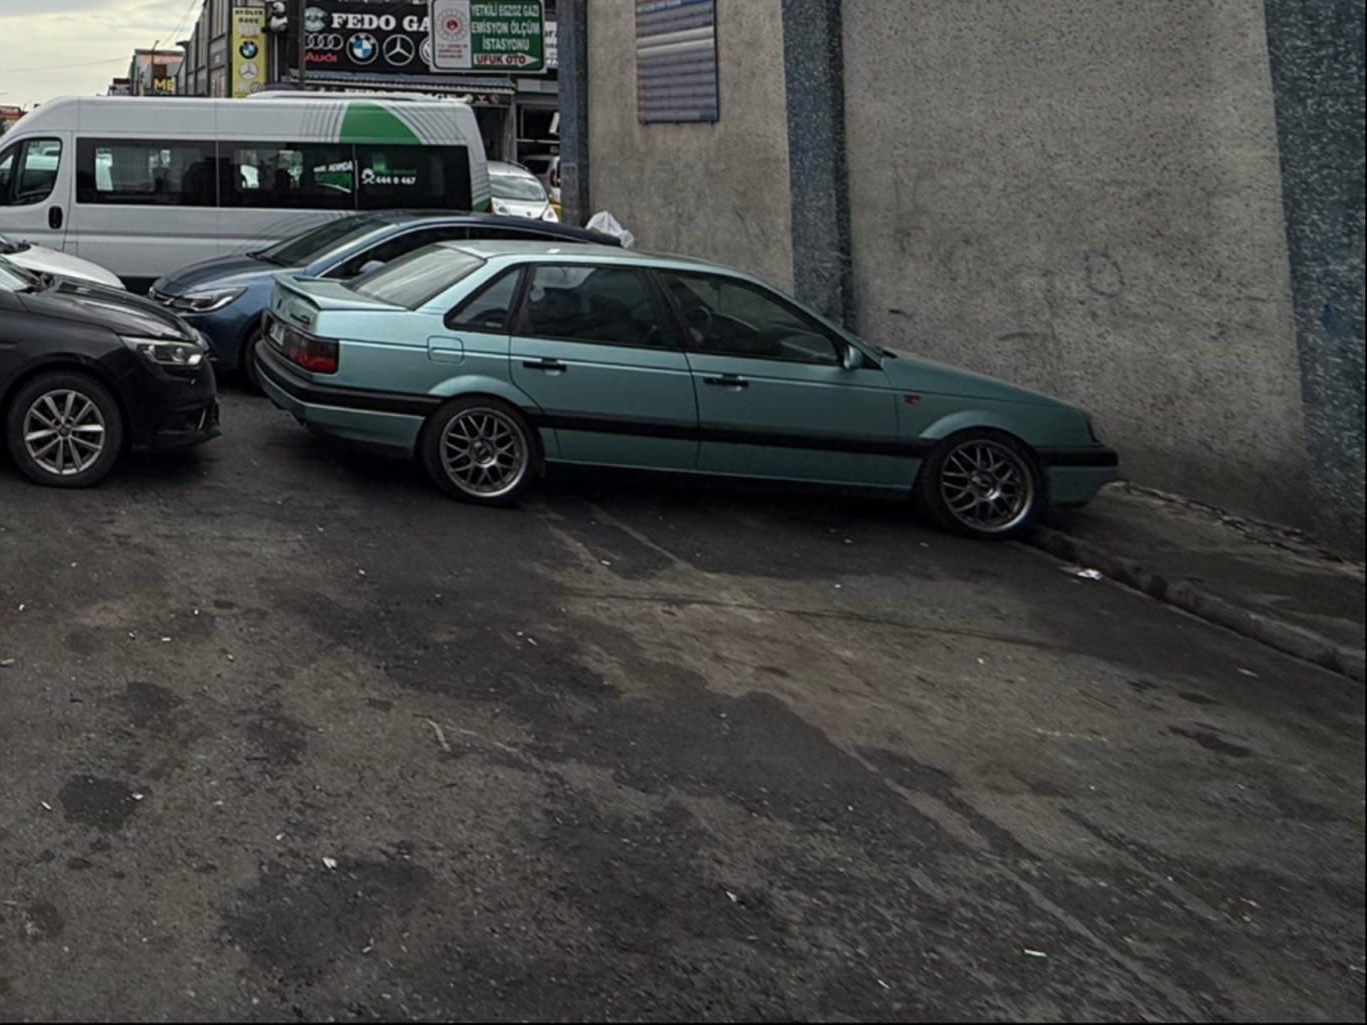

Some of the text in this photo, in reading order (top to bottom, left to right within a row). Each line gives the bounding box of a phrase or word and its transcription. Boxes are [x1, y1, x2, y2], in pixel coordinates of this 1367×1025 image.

[331, 12, 397, 30] FEDO
[472, 19, 540, 37] EMİSYON ÖLÇÜM
[482, 35, 529, 50] İSTASYONU
[476, 55, 526, 64] UFUK OTO
